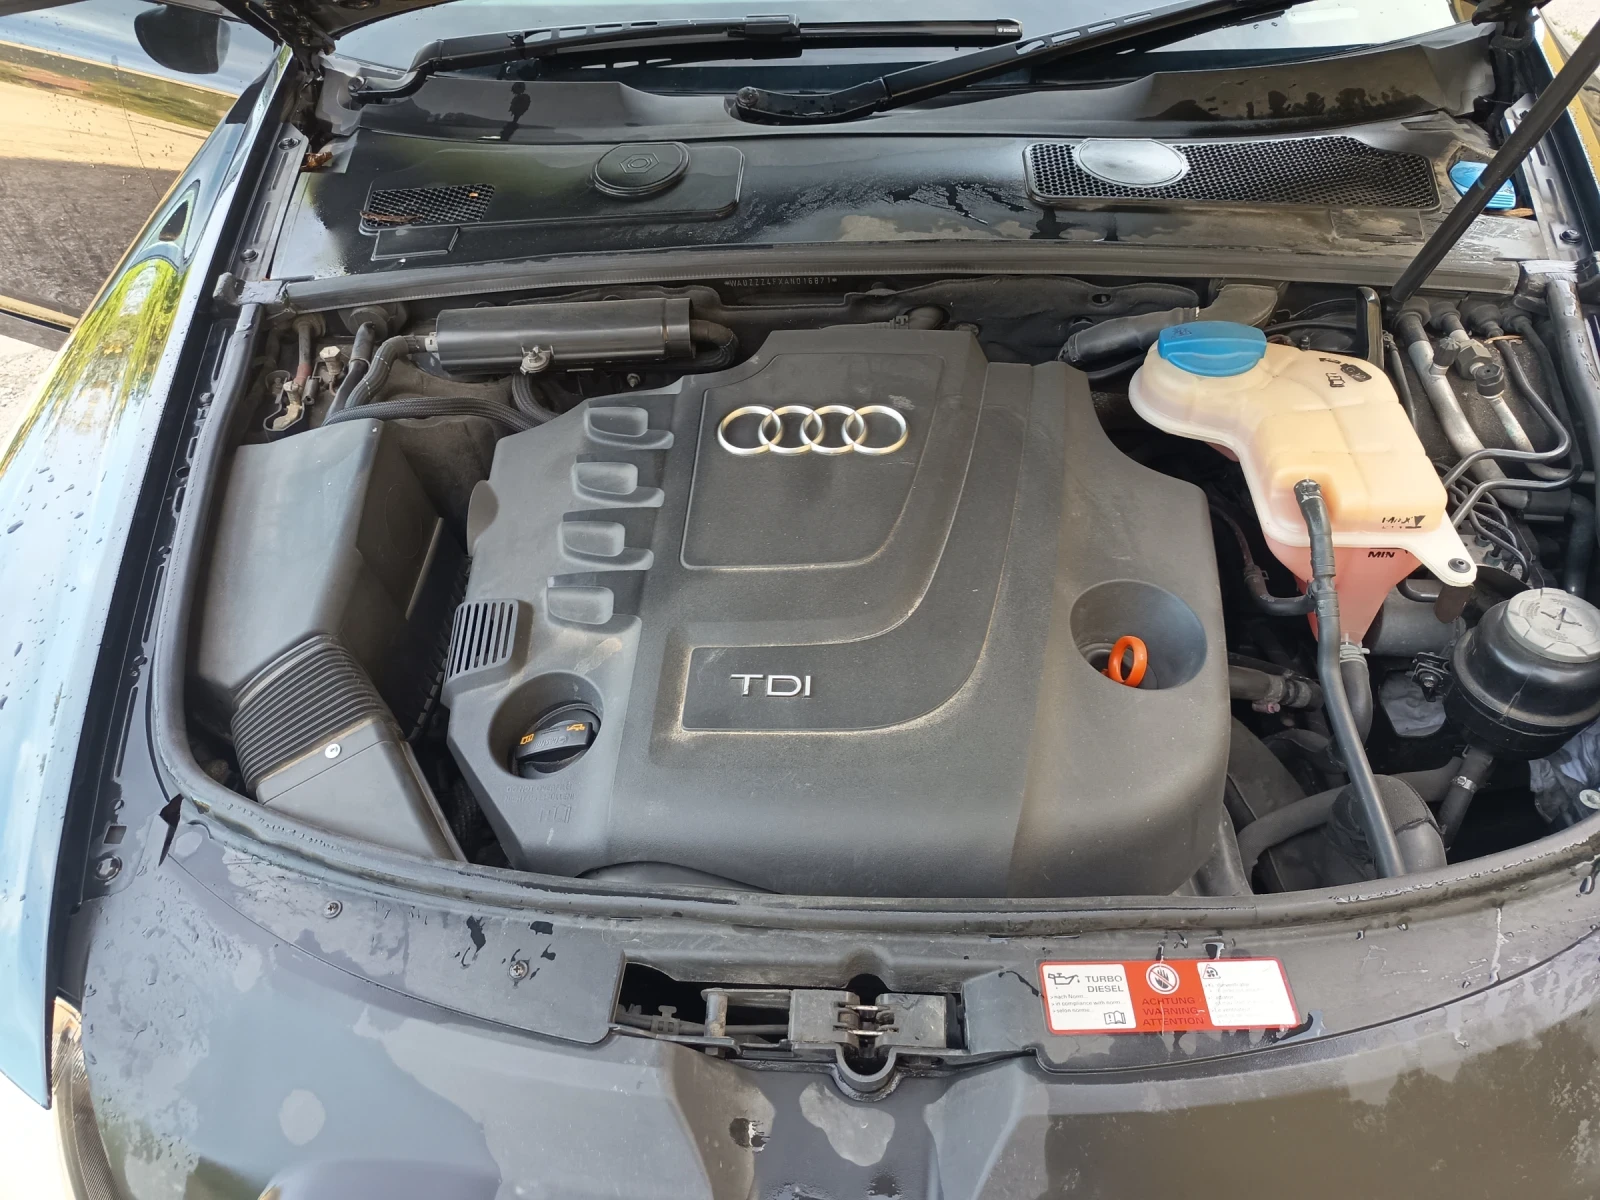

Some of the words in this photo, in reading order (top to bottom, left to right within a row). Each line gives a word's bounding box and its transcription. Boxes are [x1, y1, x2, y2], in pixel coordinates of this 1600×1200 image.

[730, 673, 811, 697] TDI
[1085, 975, 1123, 983] TURBO
[1087, 985, 1124, 993] DIESEL
[1142, 996, 1196, 1006] ACHTUNG
[1143, 1006, 1198, 1016] WARNING
[1143, 1017, 1204, 1026] ATTENTION
